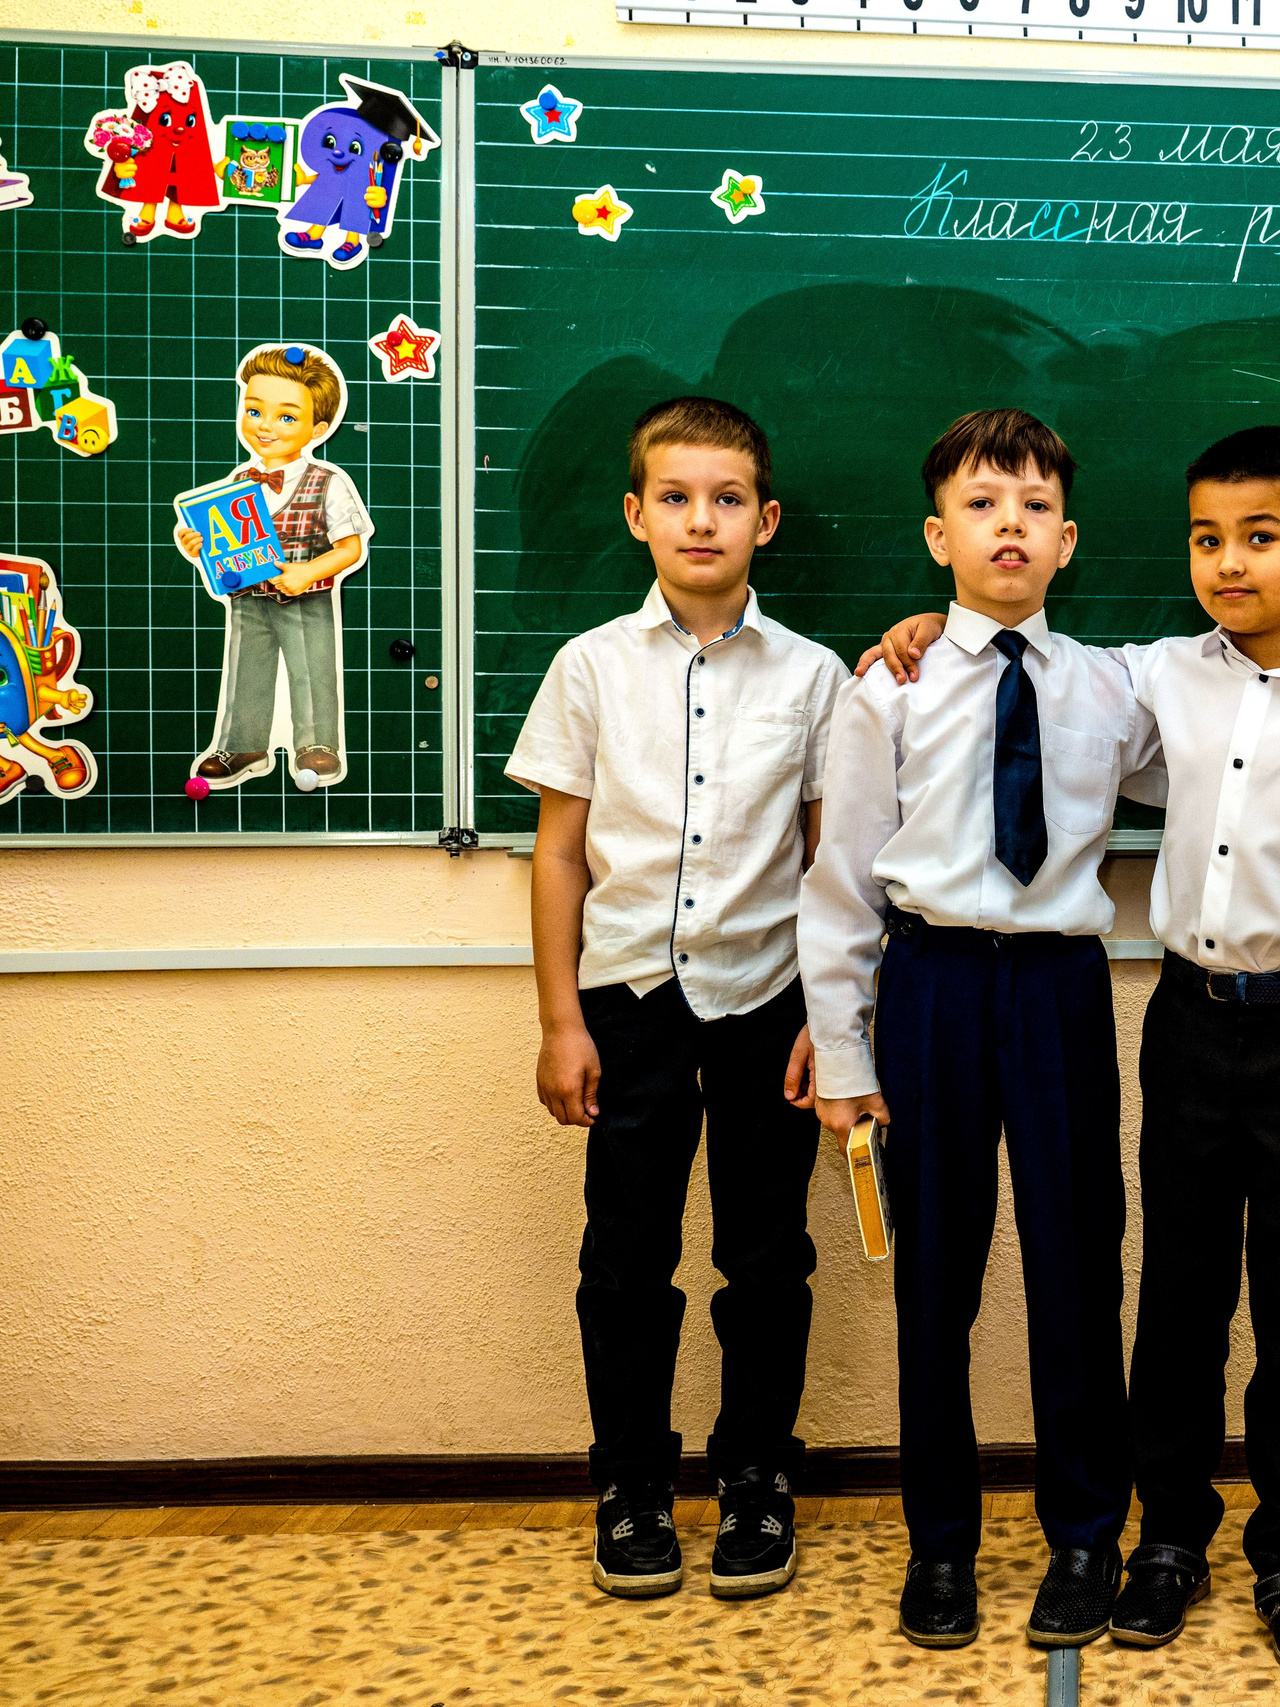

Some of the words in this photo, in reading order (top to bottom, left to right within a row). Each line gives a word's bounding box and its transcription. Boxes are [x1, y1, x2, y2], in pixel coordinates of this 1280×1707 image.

[1070, 119, 1133, 163] 23
[903, 162, 1203, 245] Классная
[9, 357, 37, 384] А
[48, 355, 79, 382] Ж
[0, 396, 24, 426] Б
[215, 543, 280, 579] АЗБУКА
